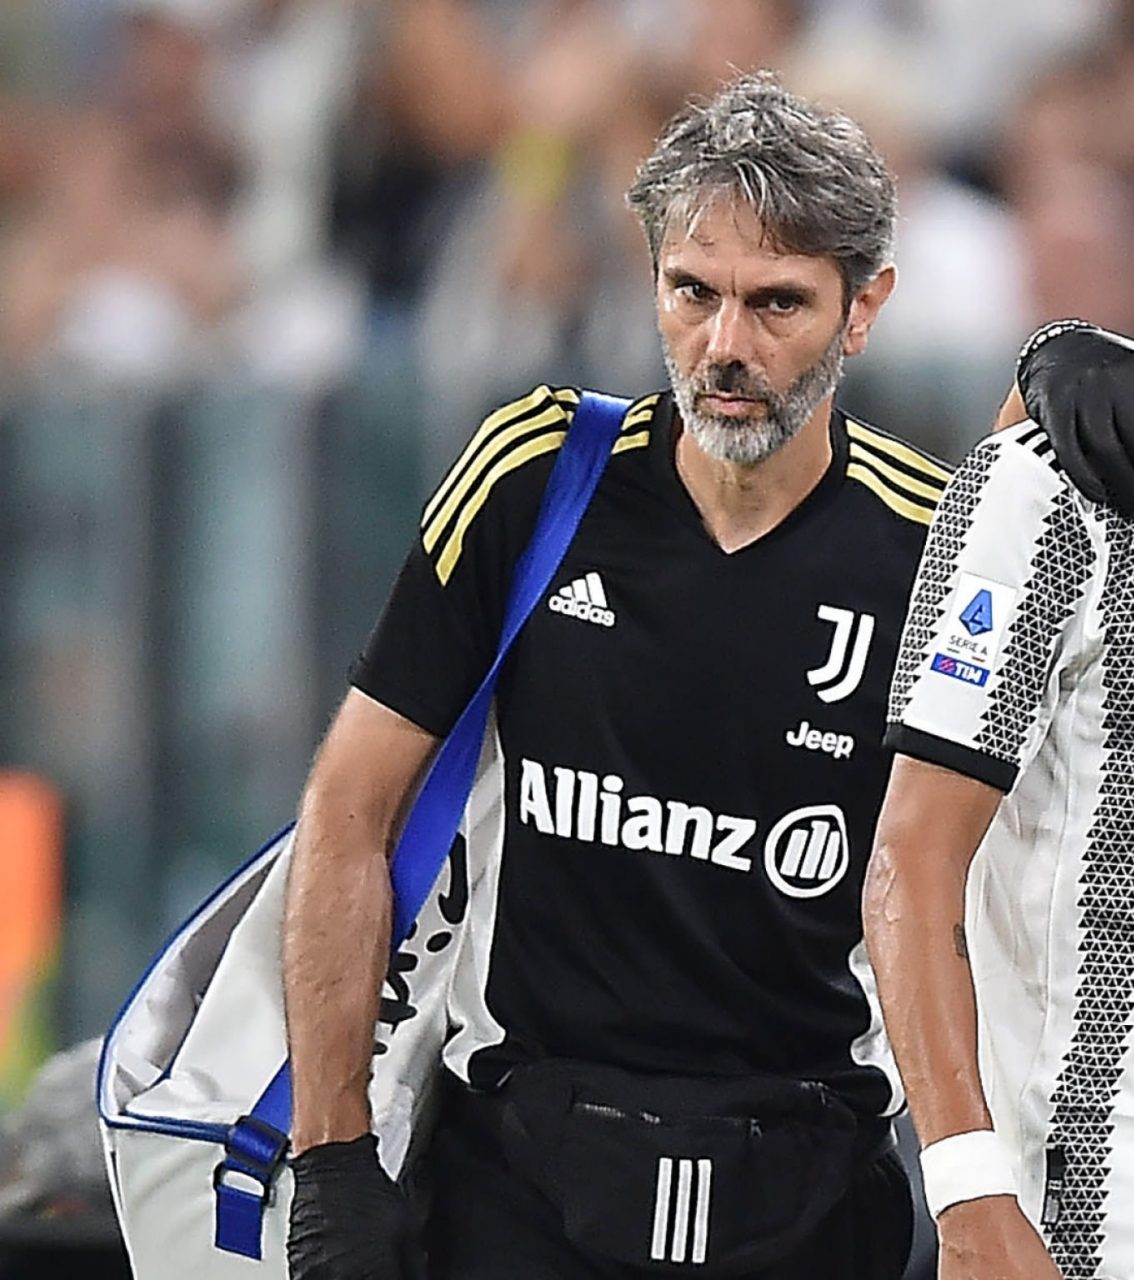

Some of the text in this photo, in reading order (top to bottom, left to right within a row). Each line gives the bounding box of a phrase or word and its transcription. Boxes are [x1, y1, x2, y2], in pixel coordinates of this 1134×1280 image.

[549, 594, 616, 628] adidas
[948, 635, 988, 656] SERIE A
[955, 661, 983, 684] TIM
[786, 721, 855, 760] Jeep
[520, 758, 757, 872] Allianz
